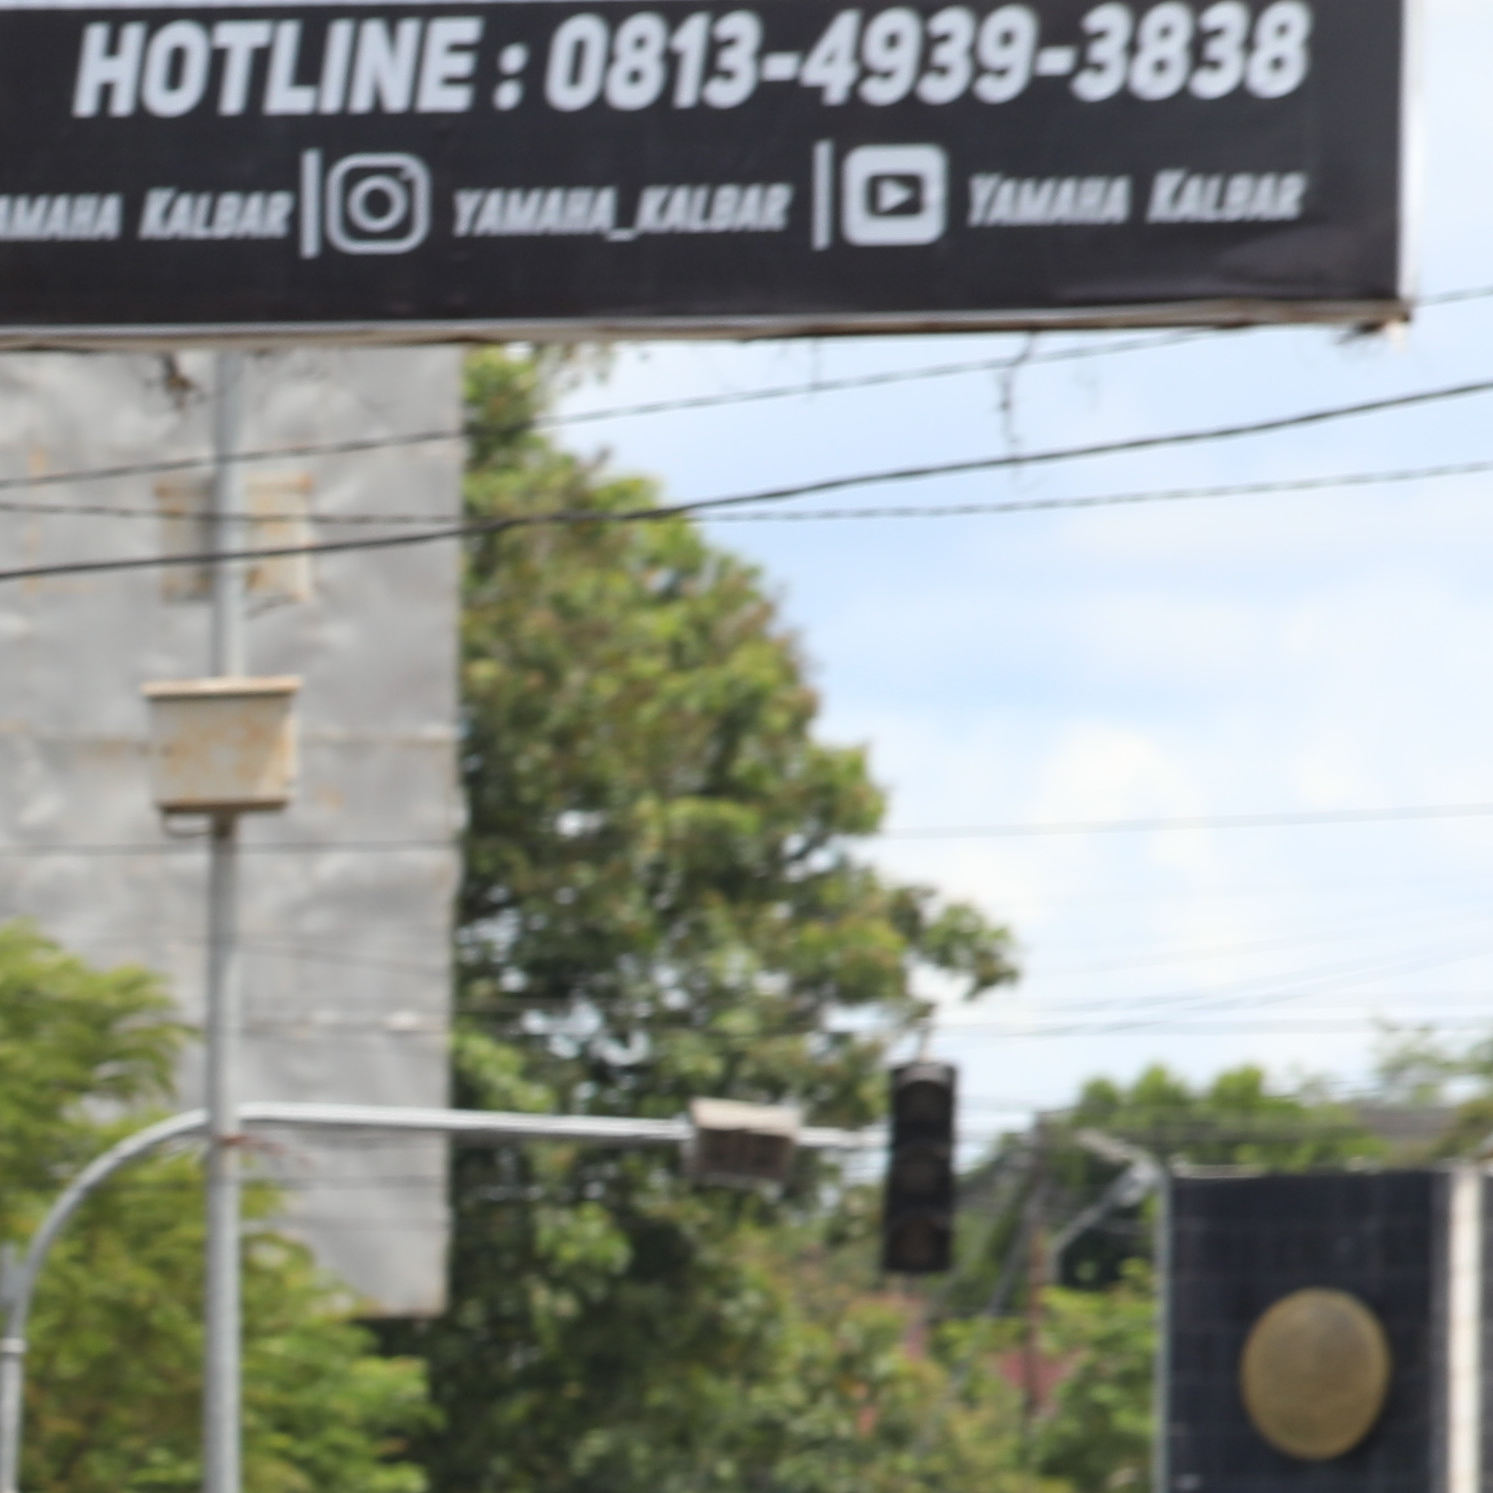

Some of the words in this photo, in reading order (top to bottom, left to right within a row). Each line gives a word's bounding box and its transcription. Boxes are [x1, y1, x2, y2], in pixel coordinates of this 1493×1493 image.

[73, 16, 483, 118] HOTLINE
[545, 1, 1313, 111] 0813-4939-3838
[138, 187, 294, 240] KALBAR
[452, 182, 794, 242] YAMAHA_KALBAR
[967, 173, 1131, 226] YAMAHA
[1146, 168, 1308, 223] KALBAR
